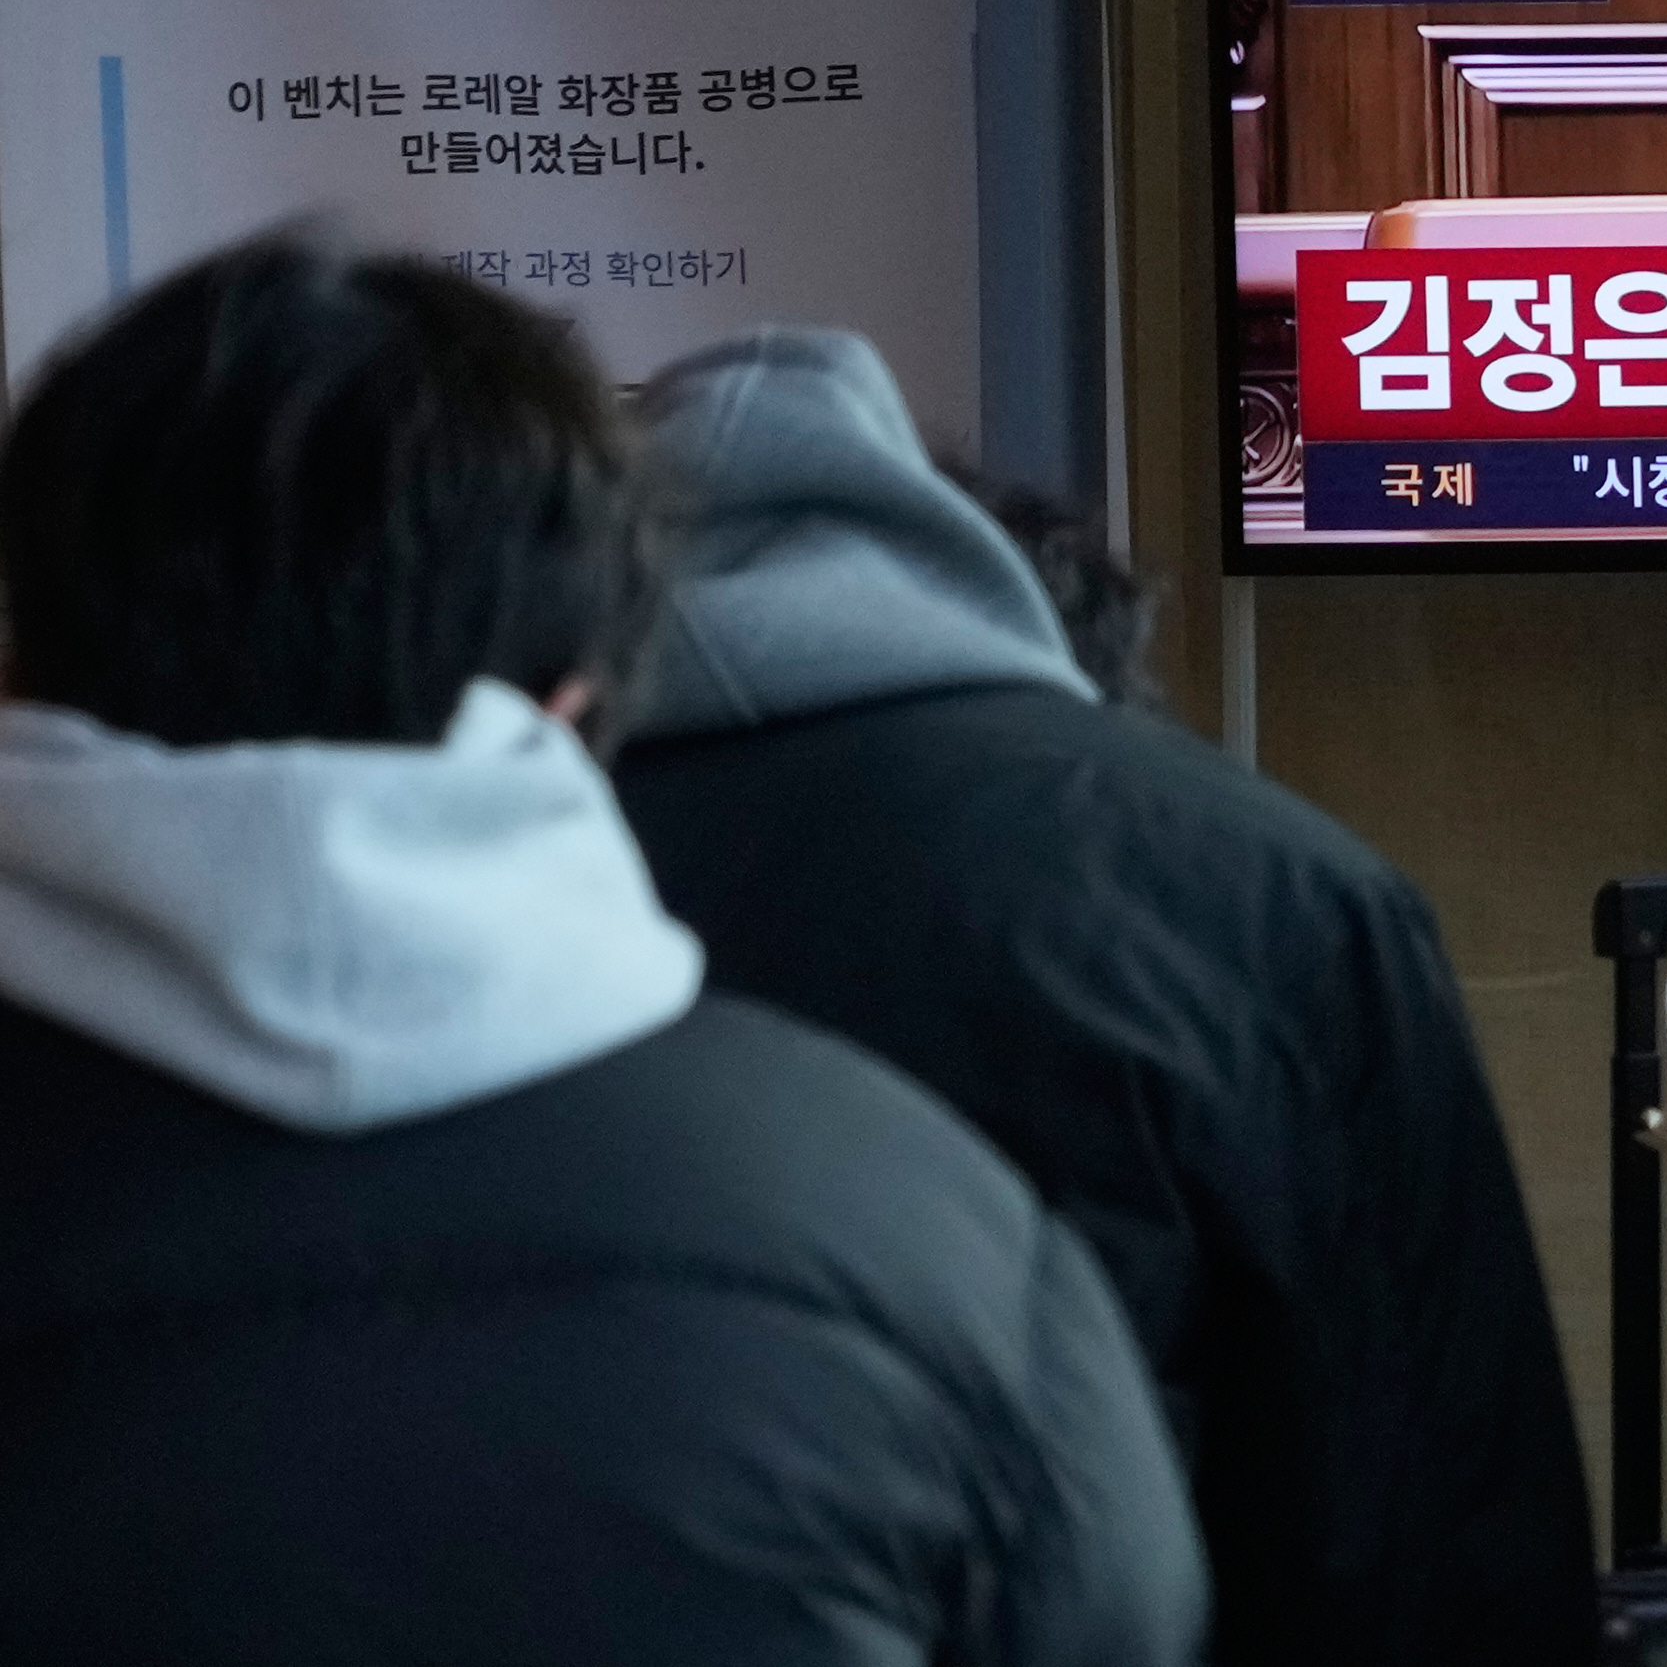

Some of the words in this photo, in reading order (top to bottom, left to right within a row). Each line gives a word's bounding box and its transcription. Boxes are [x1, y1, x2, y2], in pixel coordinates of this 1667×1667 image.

[228, 77, 264, 122] 이
[283, 73, 406, 120] 벤치는
[422, 73, 543, 117] 로레알
[557, 71, 682, 117] 화장품
[697, 63, 863, 113] 공병으로
[401, 129, 706, 176] 만들어졌습니다.
[524, 249, 591, 288] 과정
[606, 247, 747, 288] 확인하기
[1380, 462, 1473, 507] 국제
